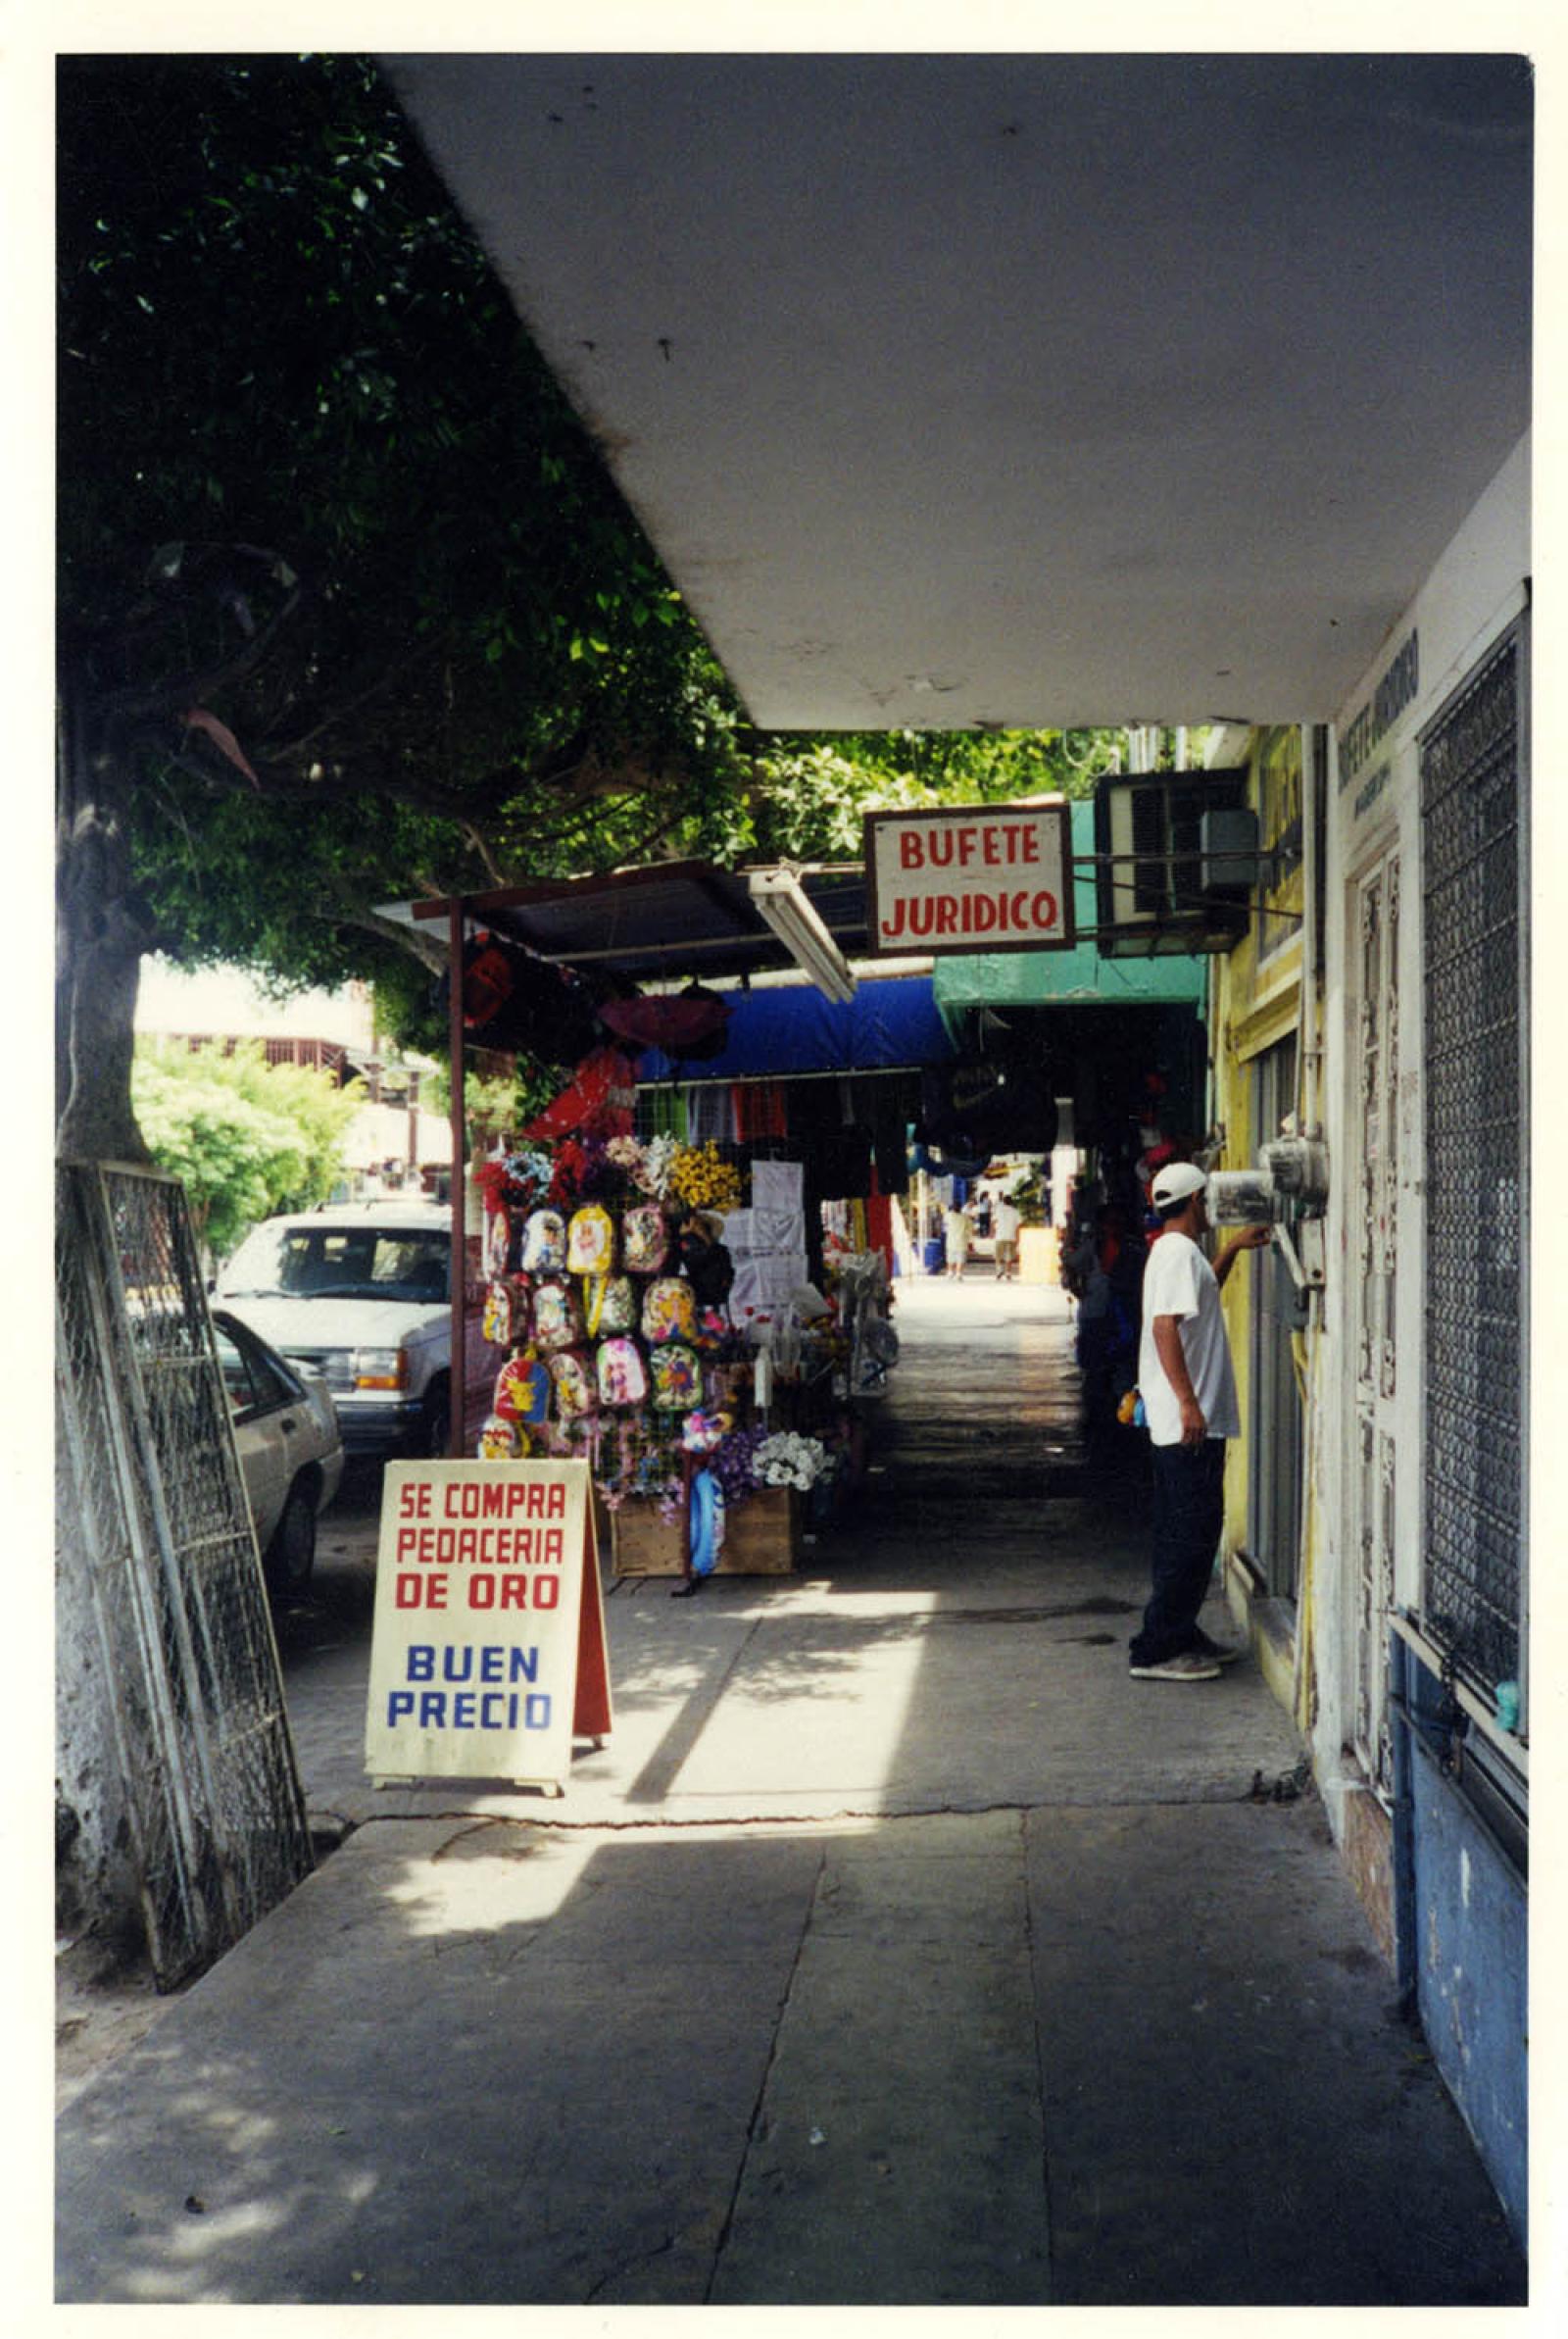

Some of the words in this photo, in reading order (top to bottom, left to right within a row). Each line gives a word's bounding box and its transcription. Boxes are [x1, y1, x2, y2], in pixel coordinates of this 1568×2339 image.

[900, 824, 1040, 870] BUFETE
[883, 890, 1057, 936] JURIDICO
[399, 1483, 431, 1518] SE
[444, 1483, 565, 1518] COMPRA
[397, 1528, 564, 1564] PEDACERIA
[396, 1573, 448, 1610] DE
[468, 1573, 559, 1610] ORO
[407, 1645, 539, 1682] BUEN
[387, 1691, 552, 1729] PRECIO
